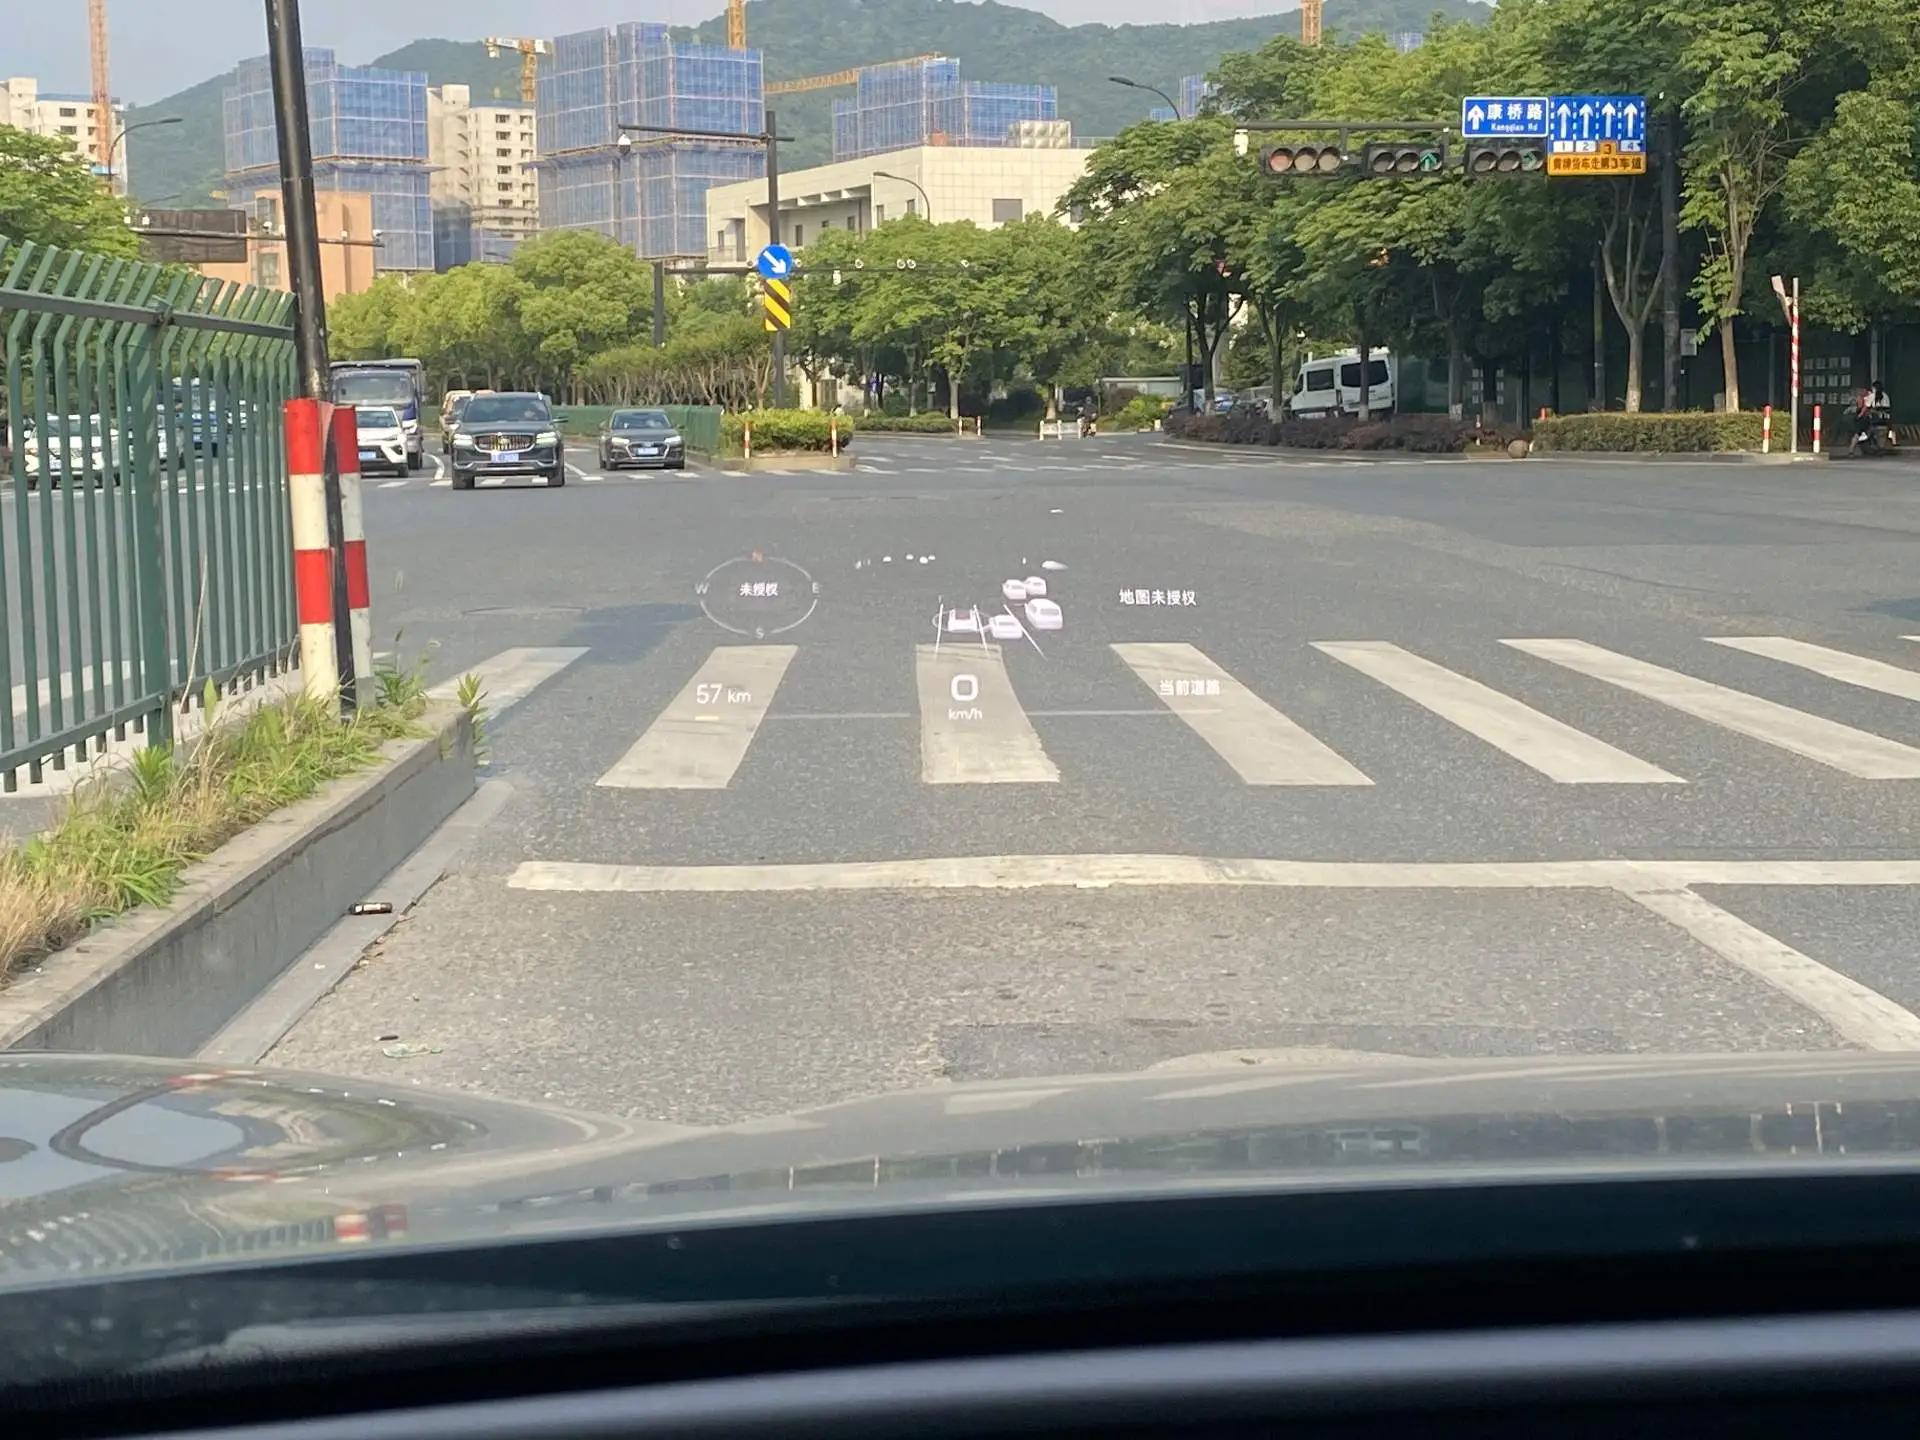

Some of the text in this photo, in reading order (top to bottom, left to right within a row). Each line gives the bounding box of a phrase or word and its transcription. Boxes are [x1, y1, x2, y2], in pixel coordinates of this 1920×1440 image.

[1487, 103, 1543, 121] 康桥路
[1603, 144, 1612, 155] 3
[739, 582, 779, 598] 未授权
[1119, 588, 1197, 606] 地图未授权
[755, 626, 765, 639] S
[696, 683, 752, 705] 57 km
[951, 674, 979, 701] 0
[948, 707, 983, 721] km/h
